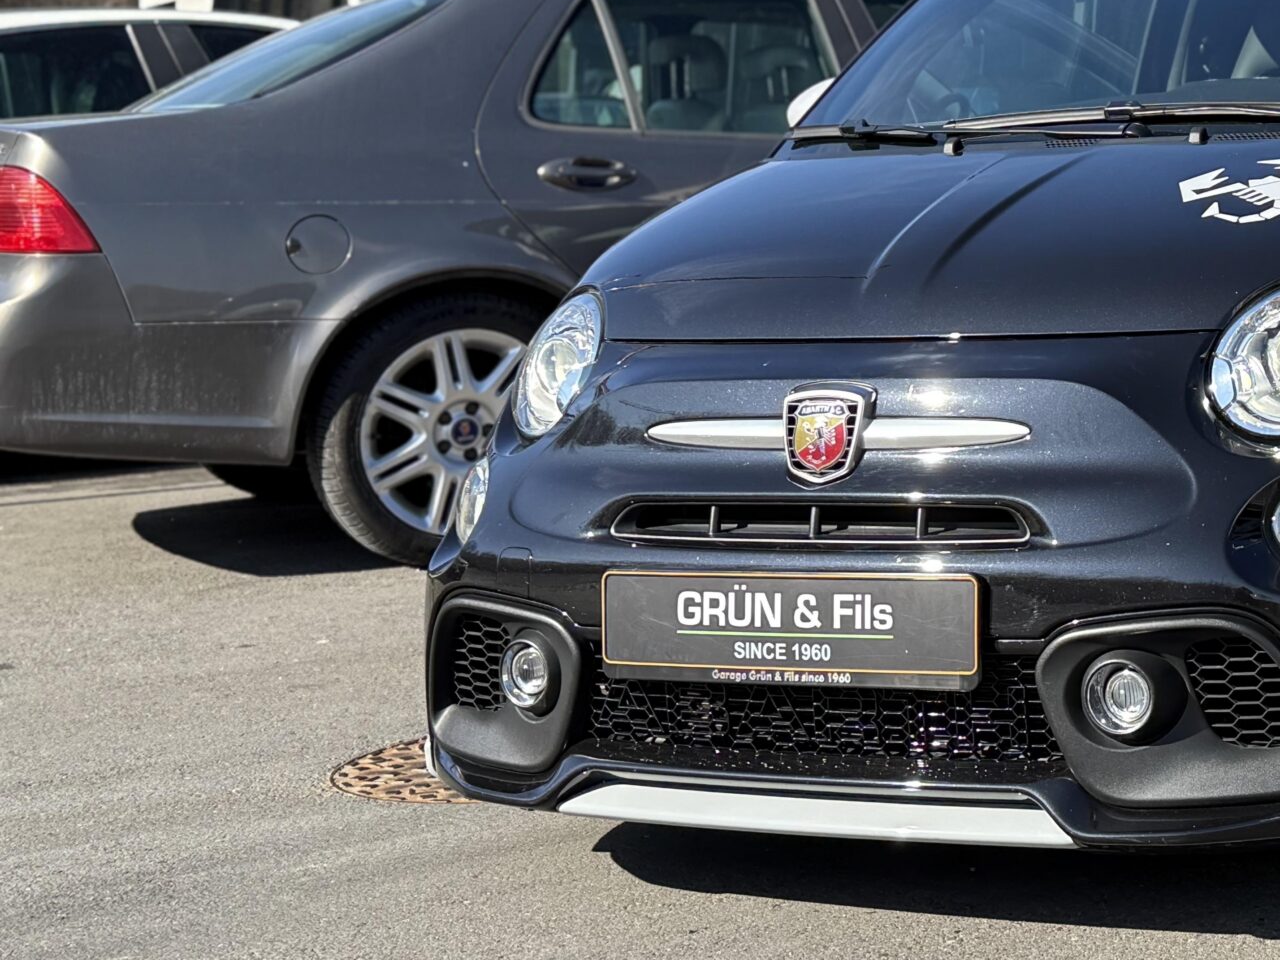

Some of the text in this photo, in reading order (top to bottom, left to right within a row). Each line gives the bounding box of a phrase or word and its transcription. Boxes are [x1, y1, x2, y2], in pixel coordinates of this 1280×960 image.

[676, 584, 894, 631] GRÜN & Fils
[733, 641, 832, 662] SINCE 1960
[711, 668, 852, 684] Garage Grün & Fils since 1960
